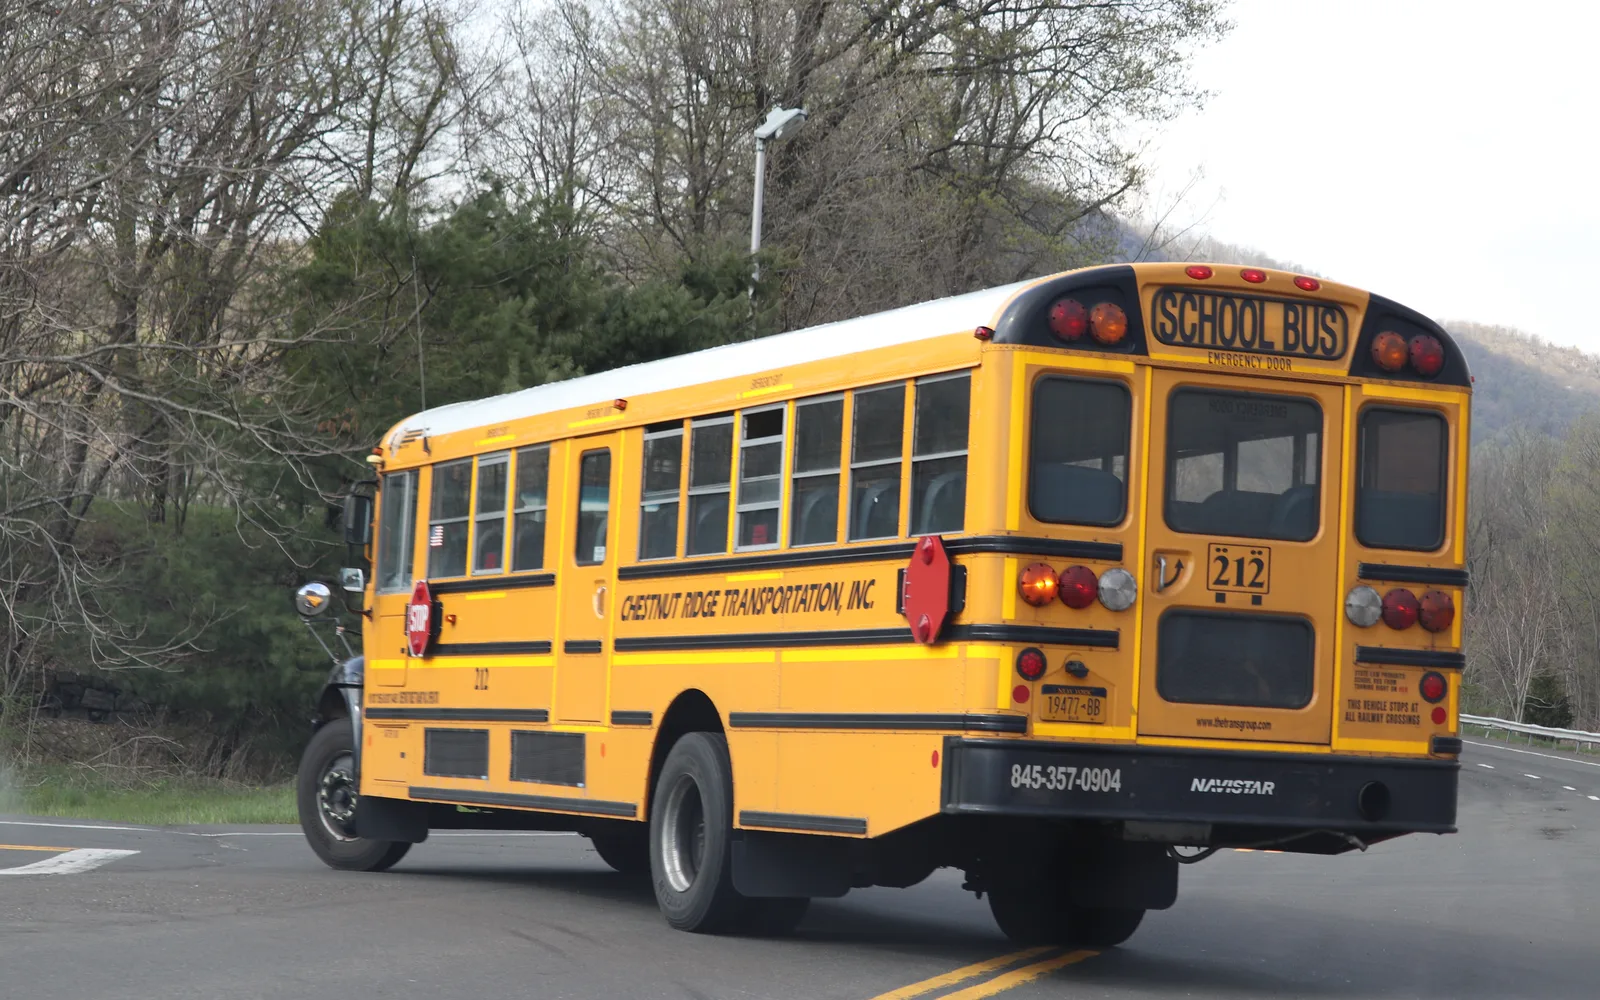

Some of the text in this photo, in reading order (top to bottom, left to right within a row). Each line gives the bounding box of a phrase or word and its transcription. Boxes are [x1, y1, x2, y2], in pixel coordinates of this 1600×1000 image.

[1159, 290, 1339, 357] SCHOOL BUS
[1207, 350, 1292, 371] EMERGENCY DOOR
[1212, 555, 1265, 589] 212
[620, 592, 682, 622] CHESTNUT
[681, 590, 721, 618] RIDGE
[721, 581, 845, 617] TRANSPORTATION,
[409, 604, 429, 632] STOP
[474, 667, 489, 690] 212
[1347, 699, 1419, 713] THIS VEHICLE STOPS AT
[1196, 716, 1272, 732] www.thetransgroup.com
[1345, 711, 1420, 725] ALL RAILWAY CROSSINGS
[1010, 764, 1121, 793] 845-357-0904
[1190, 778, 1275, 795] NAVISTAR
